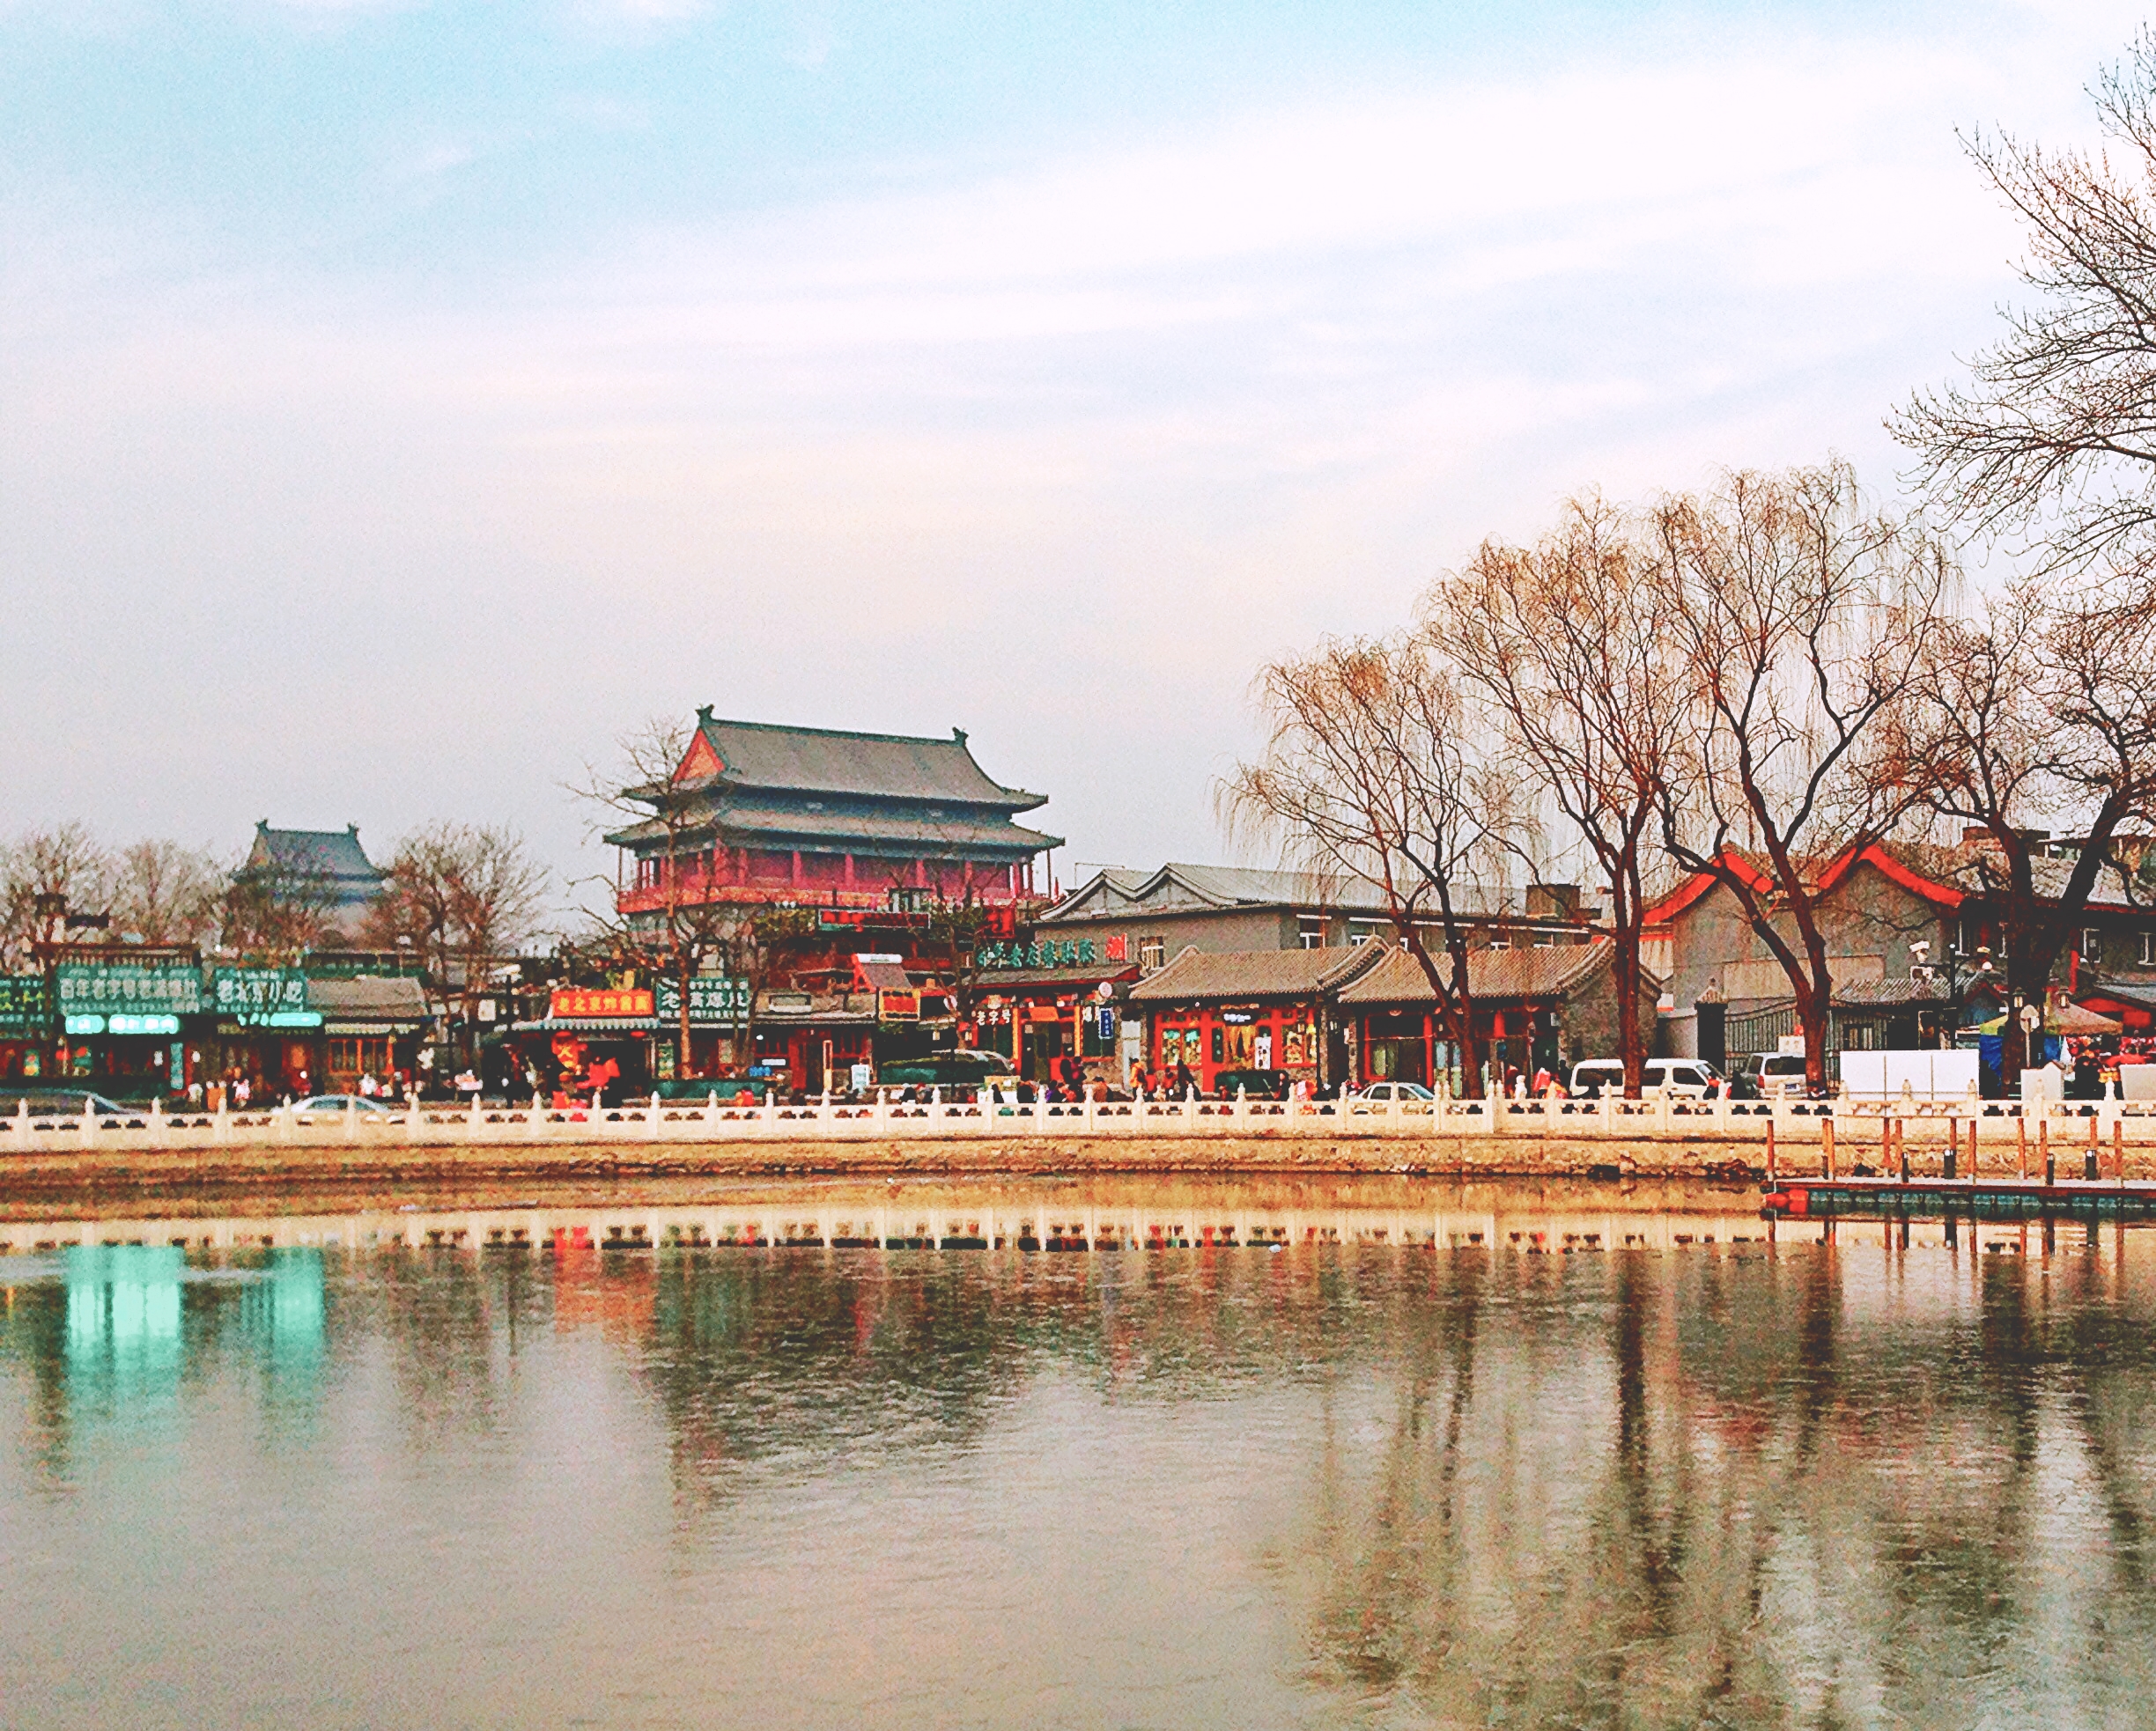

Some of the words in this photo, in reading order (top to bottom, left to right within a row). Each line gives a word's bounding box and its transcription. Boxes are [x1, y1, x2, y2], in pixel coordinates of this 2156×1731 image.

[217, 979, 304, 1004] 老北京小吃
[976, 1009, 1012, 1027] 老字号
